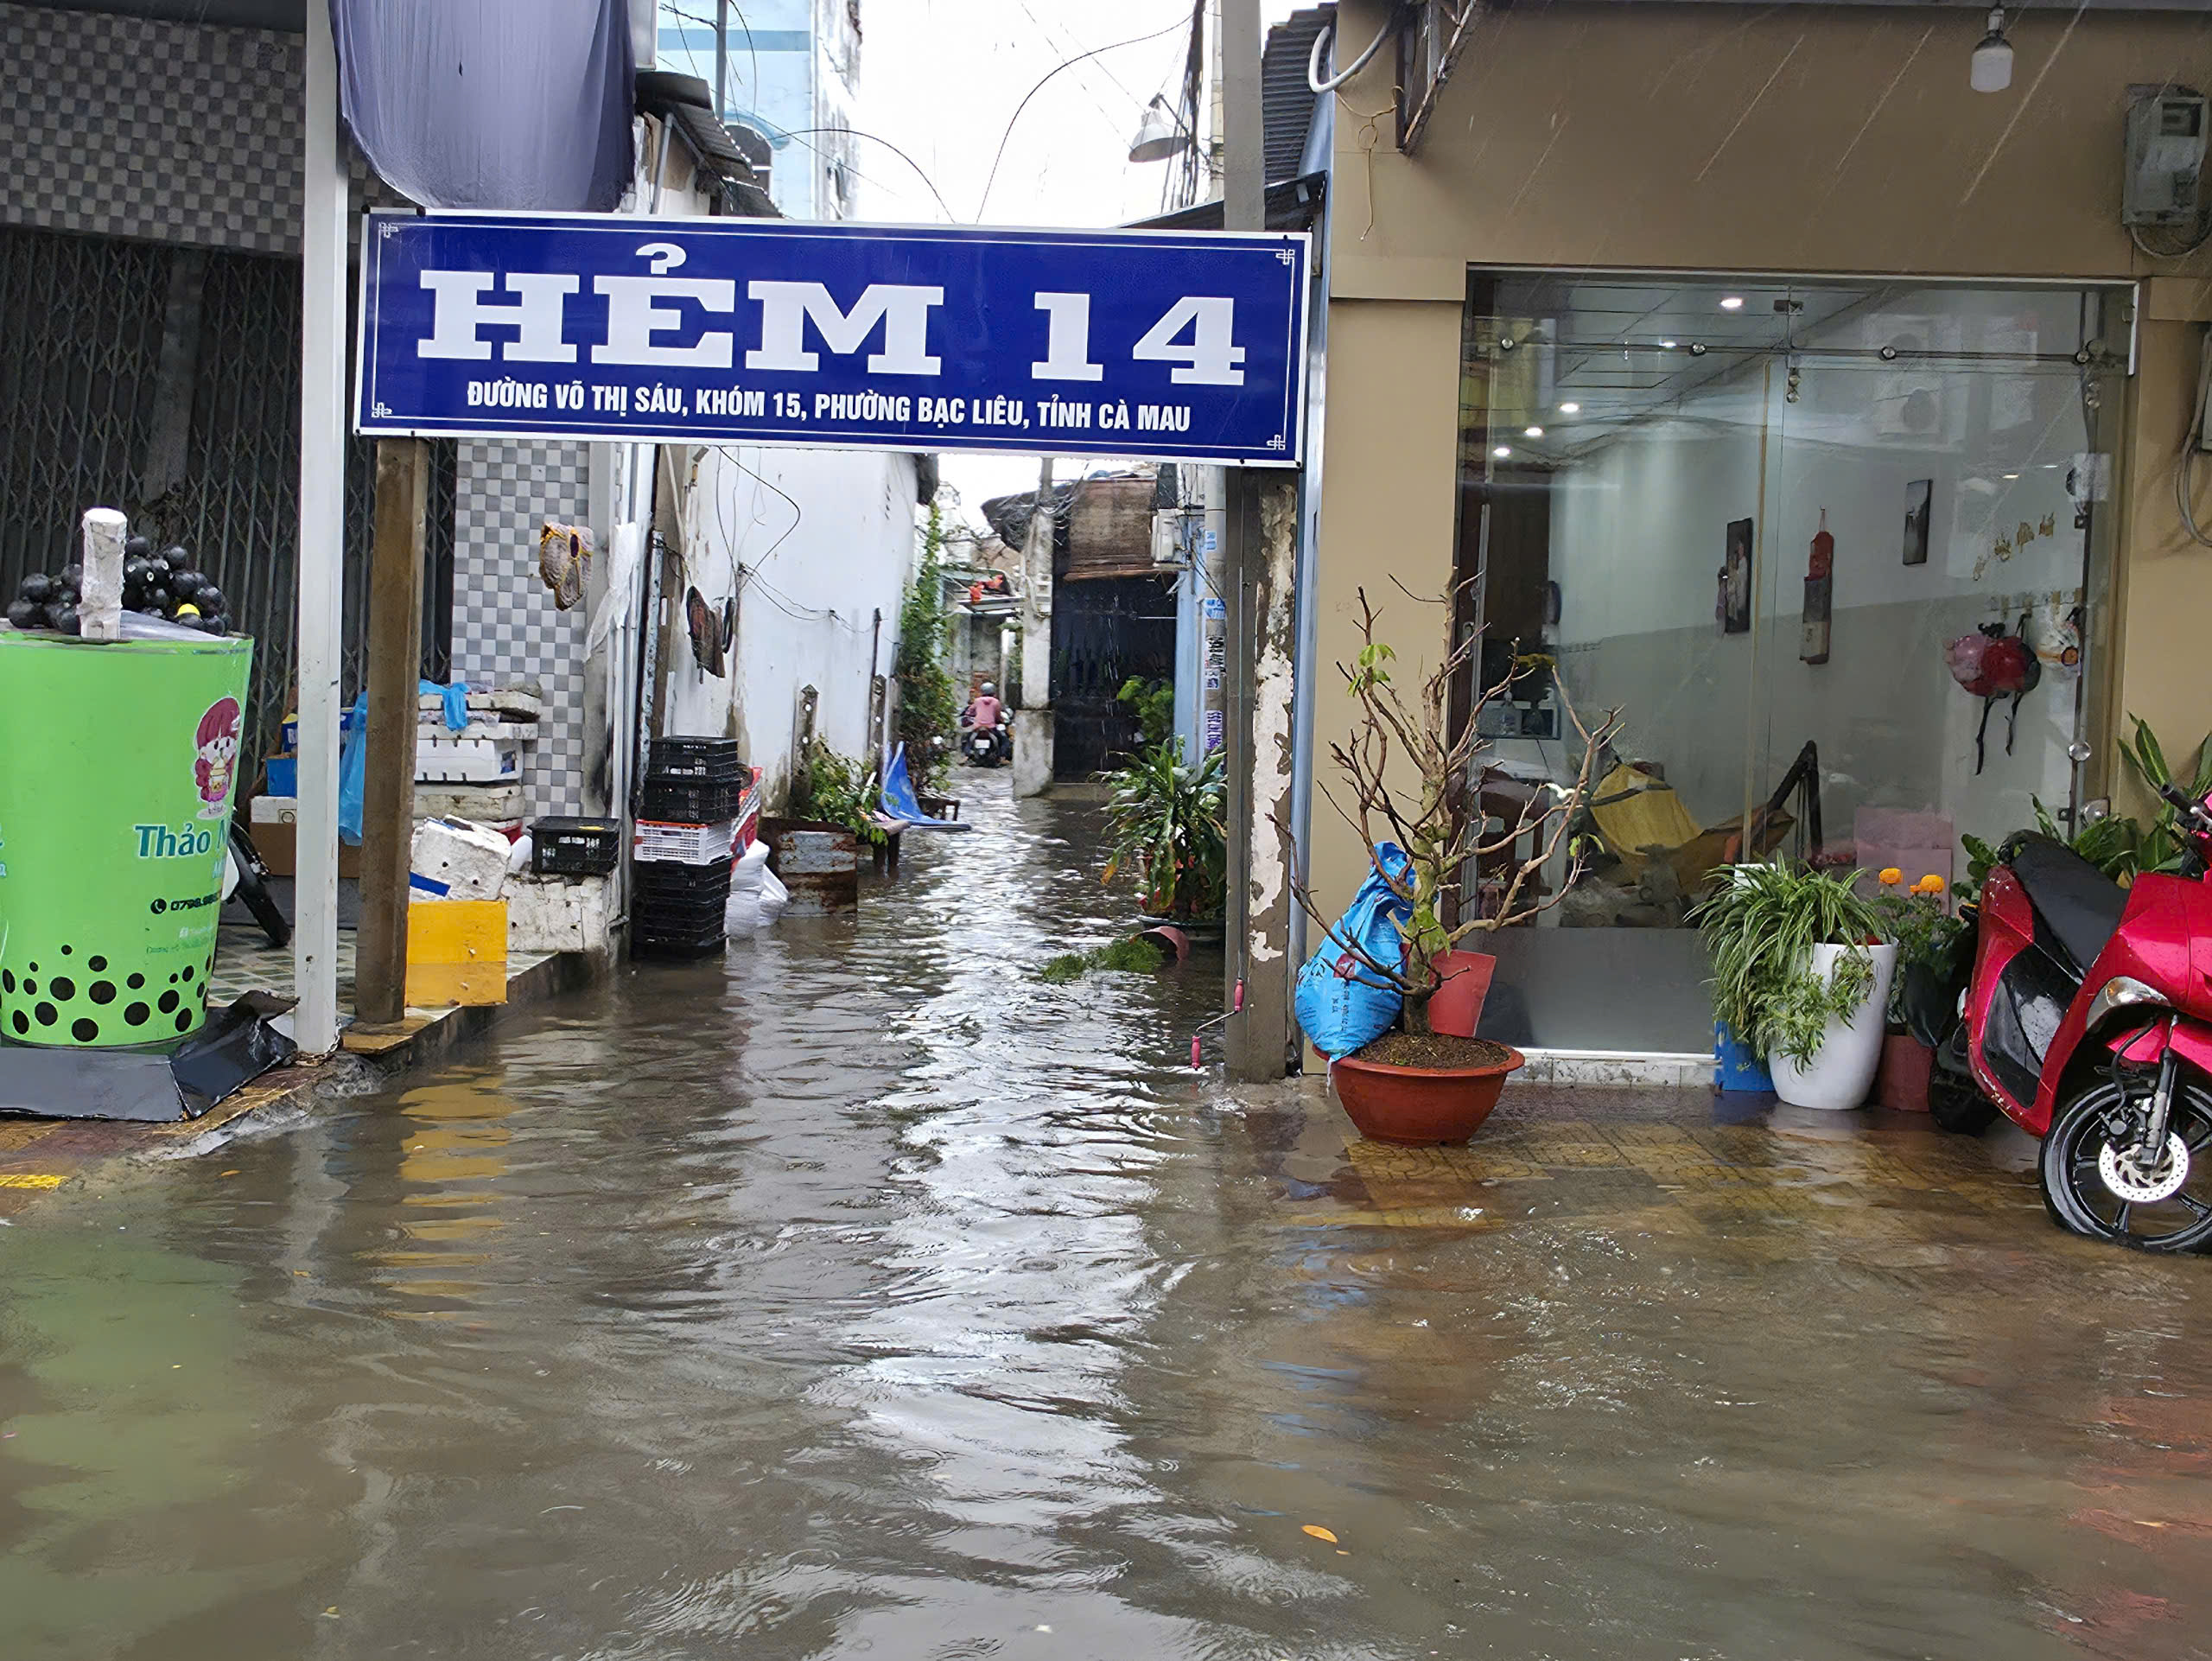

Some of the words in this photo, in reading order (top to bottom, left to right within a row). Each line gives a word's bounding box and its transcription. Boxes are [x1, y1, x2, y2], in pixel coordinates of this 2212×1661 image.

[417, 243, 944, 376] HẺM
[1032, 292, 1246, 385] 14
[467, 376, 547, 409] ĐƯỜNG
[555, 380, 584, 410] VÕ
[592, 385, 627, 417] THỊ
[635, 383, 689, 417] SÁU,
[696, 385, 766, 417] KHÓM
[773, 392, 807, 421] 15,
[815, 390, 910, 422] PHƯỜNG
[918, 397, 965, 428] BẠC
[973, 395, 1030, 429] LIÊU,
[1037, 394, 1091, 429] TỈNH
[1098, 399, 1129, 430] CÀ
[1137, 405, 1191, 431] MAU
[134, 823, 211, 857] Thảo
